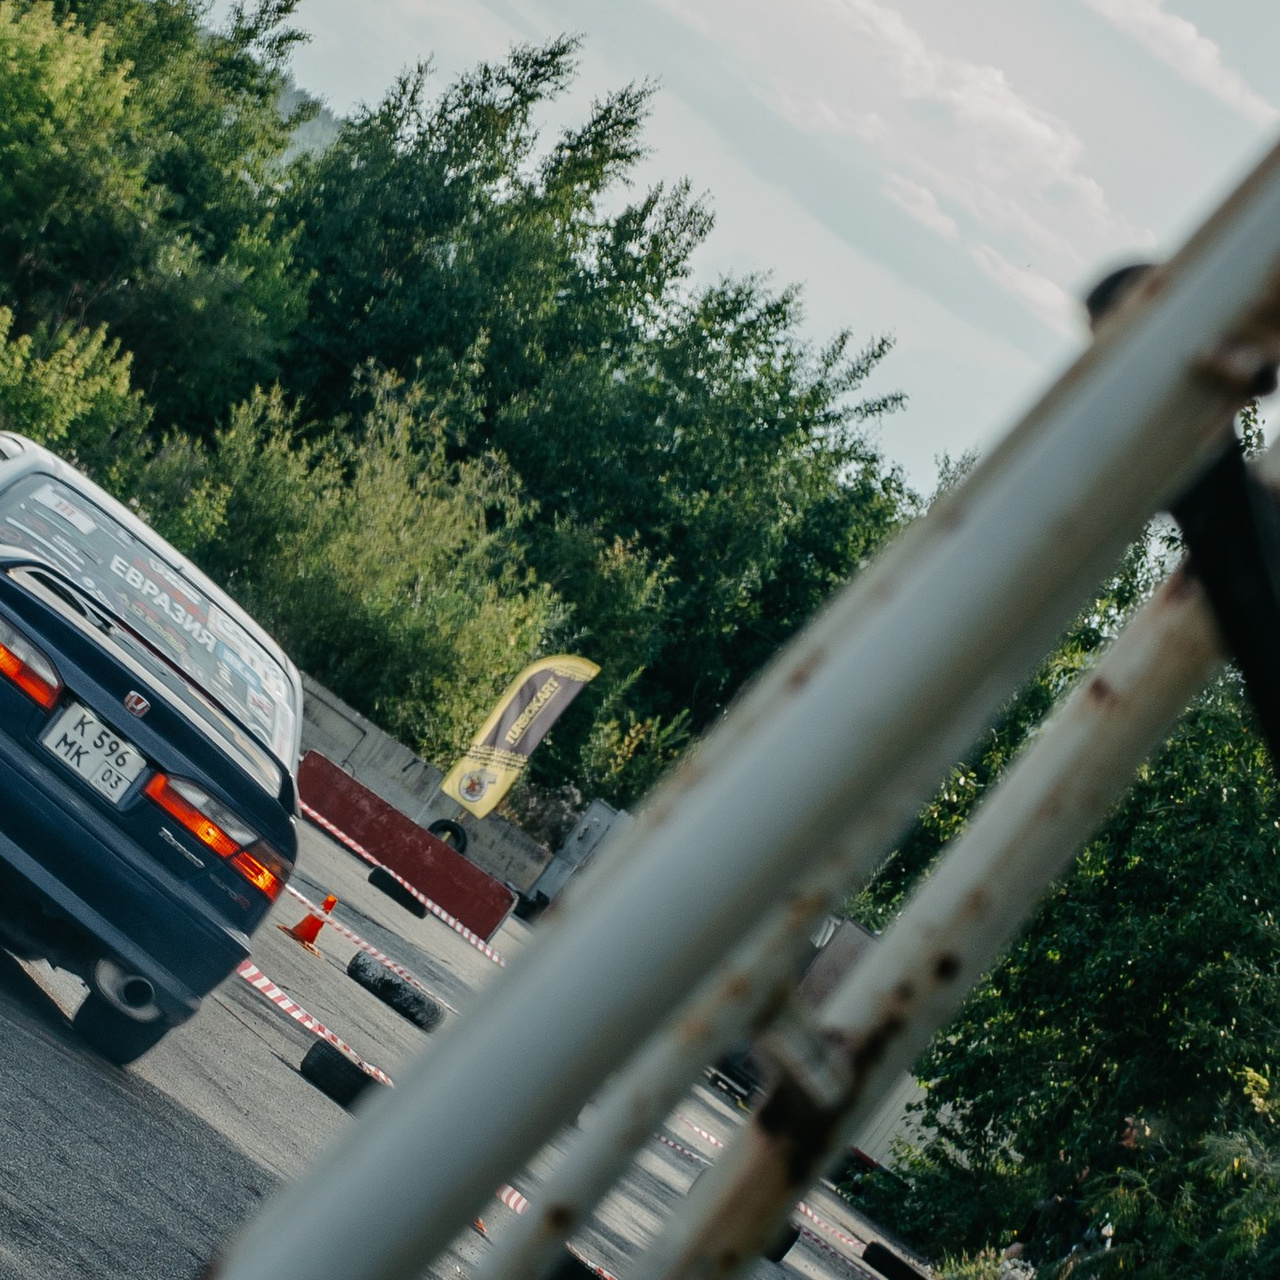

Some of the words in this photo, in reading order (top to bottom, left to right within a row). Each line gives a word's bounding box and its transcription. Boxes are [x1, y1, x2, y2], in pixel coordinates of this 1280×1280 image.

[108, 553, 217, 653] ЕВРАЗИЯ
[505, 677, 558, 744] TURBOKART
[94, 731, 131, 766] 596
[101, 769, 122, 788] 03
